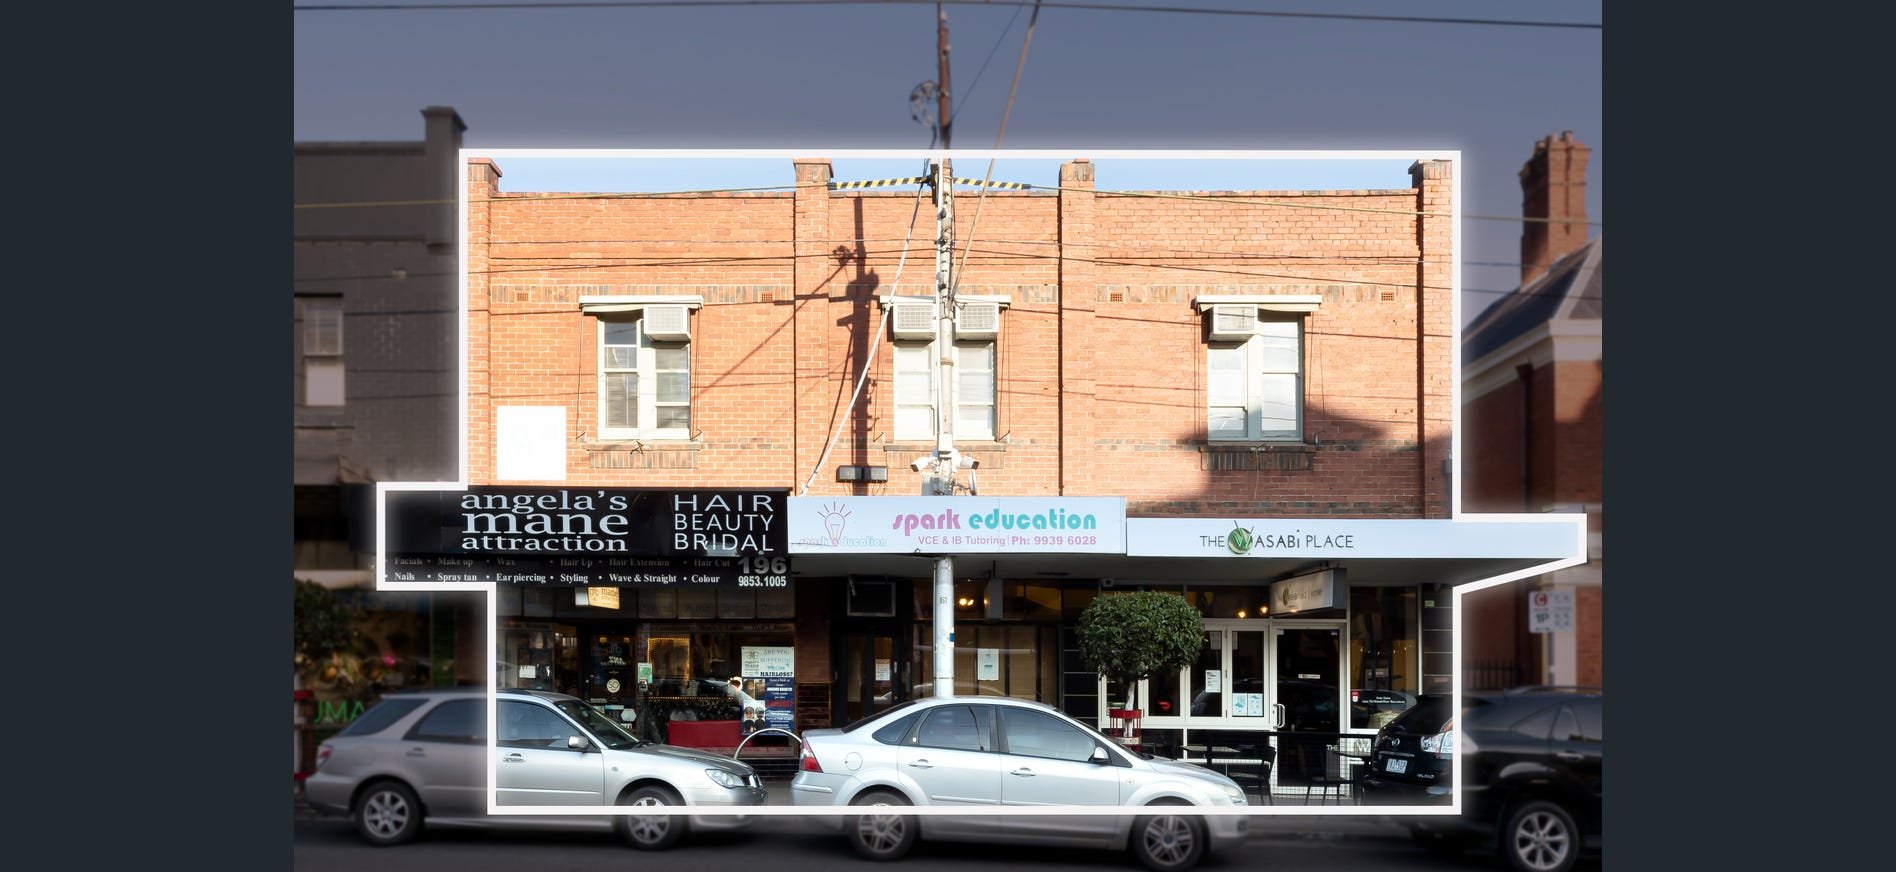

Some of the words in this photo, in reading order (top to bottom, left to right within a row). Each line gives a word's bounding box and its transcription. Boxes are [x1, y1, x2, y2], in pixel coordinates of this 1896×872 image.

[461, 490, 628, 514] angela's
[674, 494, 773, 512] HAIR
[461, 513, 629, 535] mane
[674, 513, 774, 531] BEAUTY
[892, 508, 961, 537] spark
[968, 508, 1096, 530] education
[461, 535, 628, 551] attraction
[674, 533, 774, 551] BRIDAL
[918, 536, 939, 545] VCE
[942, 536, 949, 545] &
[952, 536, 962, 545] IB
[965, 535, 1006, 547] Tutoring
[1011, 535, 1030, 545] Ph:
[1034, 535, 1063, 545] 9939
[1067, 535, 1096, 545] 6028
[1199, 535, 1225, 548] THE
[1305, 535, 1354, 548] PLACE
[497, 558, 516, 566] Wax
[560, 558, 577, 567] Hair
[609, 558, 627, 567] Hair
[737, 556, 787, 575] 196
[394, 572, 415, 581] Nails
[437, 573, 461, 582] Spray
[463, 573, 477, 581] tan
[496, 573, 512, 582] Ear
[513, 573, 546, 584] piercing
[560, 573, 589, 584] Styling
[608, 573, 632, 582] Wave
[634, 573, 642, 583] &
[643, 573, 677, 584] Straight
[691, 574, 720, 583] Colour
[738, 576, 787, 587] 9853.1005
